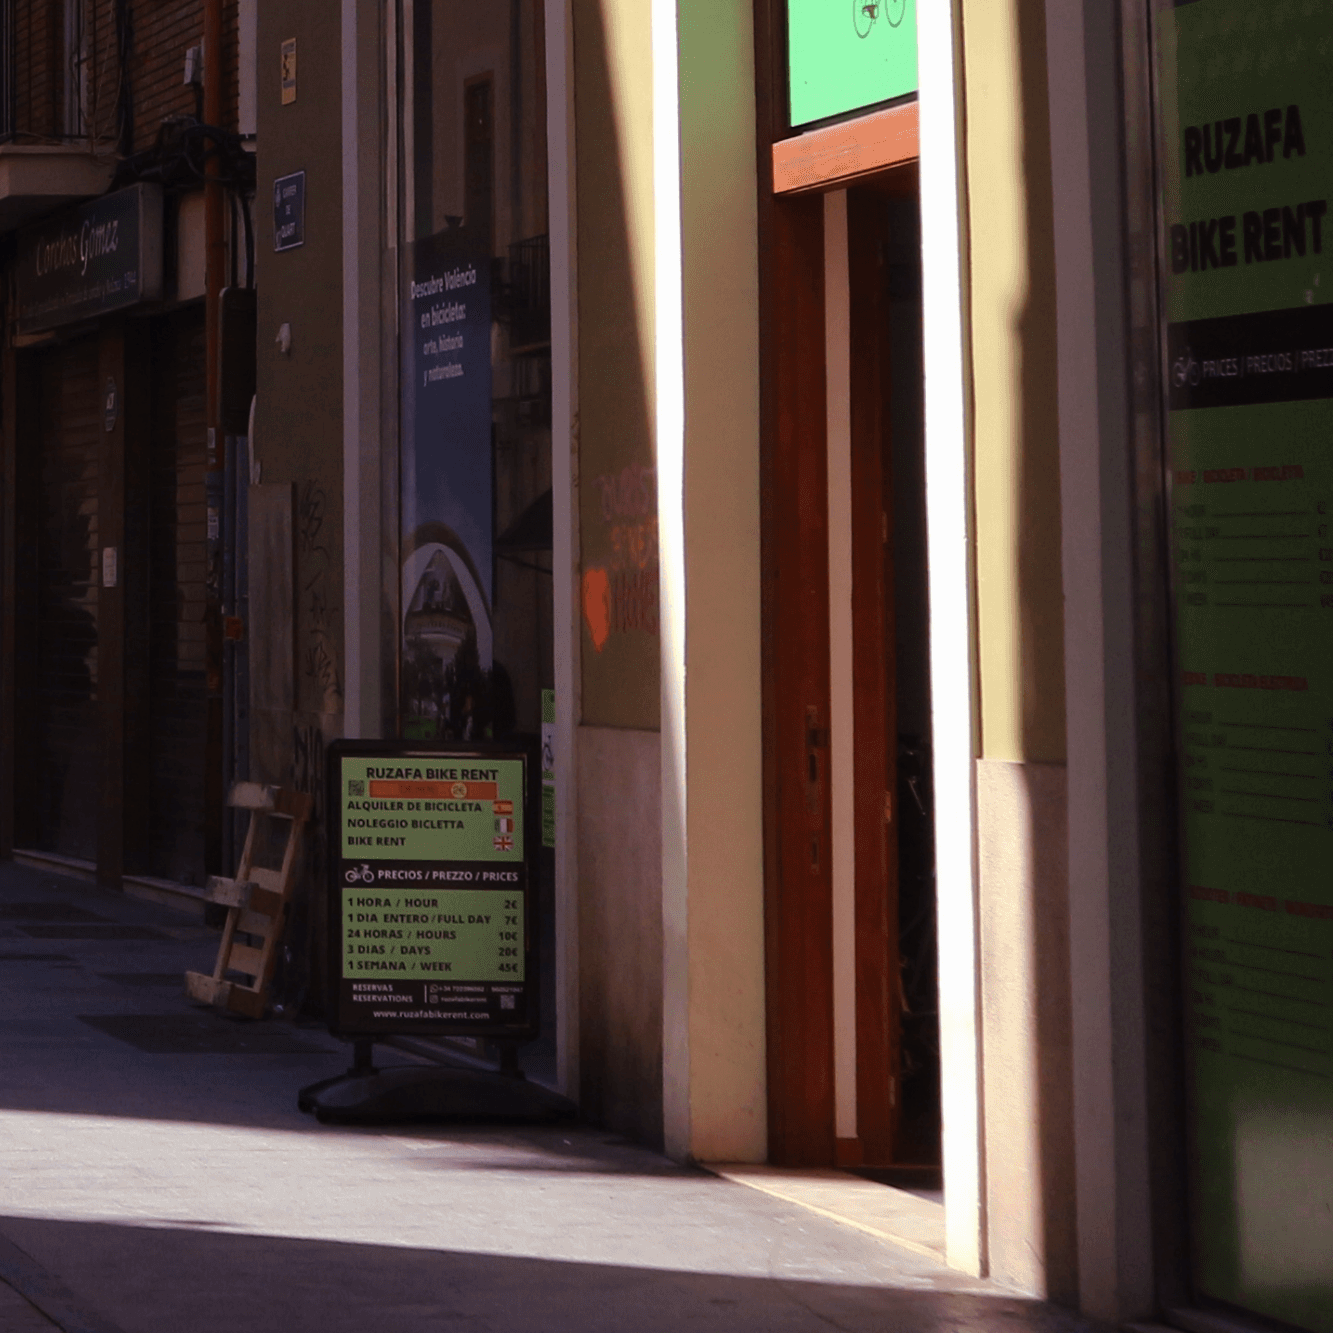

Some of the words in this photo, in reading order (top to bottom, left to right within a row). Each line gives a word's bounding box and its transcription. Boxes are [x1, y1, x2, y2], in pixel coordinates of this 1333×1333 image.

[1184, 104, 1306, 177] RUZAFA
[1170, 215, 1237, 275] BIKE
[1243, 199, 1327, 264] RENT
[1202, 358, 1238, 378] PRICES
[1246, 352, 1293, 374] PRECIOS
[367, 768, 423, 779] RUZAFA
[426, 769, 458, 780] BIKE
[462, 770, 499, 781] RENT
[348, 801, 404, 812] ALQUILER
[407, 802, 422, 812] DE
[425, 802, 482, 812] BICICLETA
[348, 819, 408, 829] NOLEGGIO
[411, 820, 465, 830] BICLETTA
[348, 836, 373, 846] BIKE
[376, 837, 406, 846] RENT
[378, 870, 423, 881] PRECIOS
[432, 871, 473, 881] PREZZO
[482, 872, 519, 882] PRICES
[357, 898, 392, 908] HORA
[405, 899, 438, 908] HOUR
[504, 900, 518, 909] 2€
[384, 914, 429, 924] ENTERO
[438, 915, 464, 924] FULL
[468, 915, 492, 925] DAY
[347, 929, 362, 938] 24
[364, 930, 404, 939] HORAS
[416, 931, 456, 940] HOURS
[499, 932, 518, 941] 10€
[358, 946, 386, 955] DIAS
[400, 946, 431, 956] DAYS
[357, 961, 407, 971] SEMANA
[420, 962, 453, 972] WEEK
[352, 983, 394, 993] RESERVAS
[352, 994, 414, 1004] RESERVATIONS
[373, 1010, 490, 1020] www.ruzafabikerent.com
